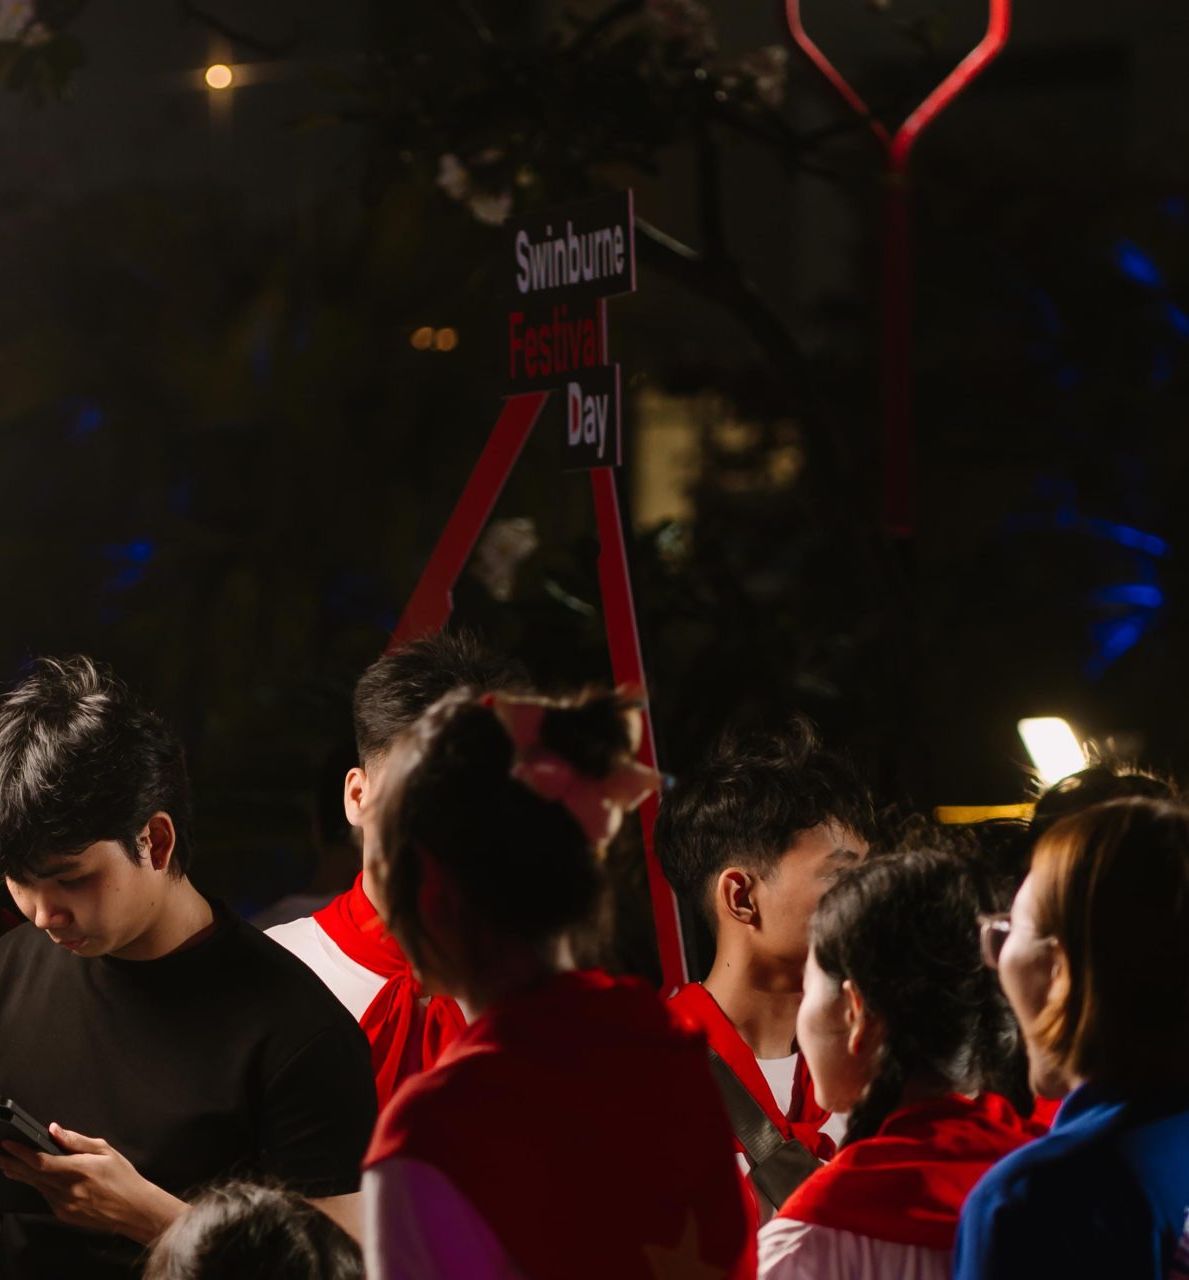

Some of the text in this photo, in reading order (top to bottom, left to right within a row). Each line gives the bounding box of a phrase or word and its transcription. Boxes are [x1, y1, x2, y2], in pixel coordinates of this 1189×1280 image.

[515, 220, 625, 294] Swinburne
[508, 304, 603, 379] Festival
[567, 382, 609, 459] Day
